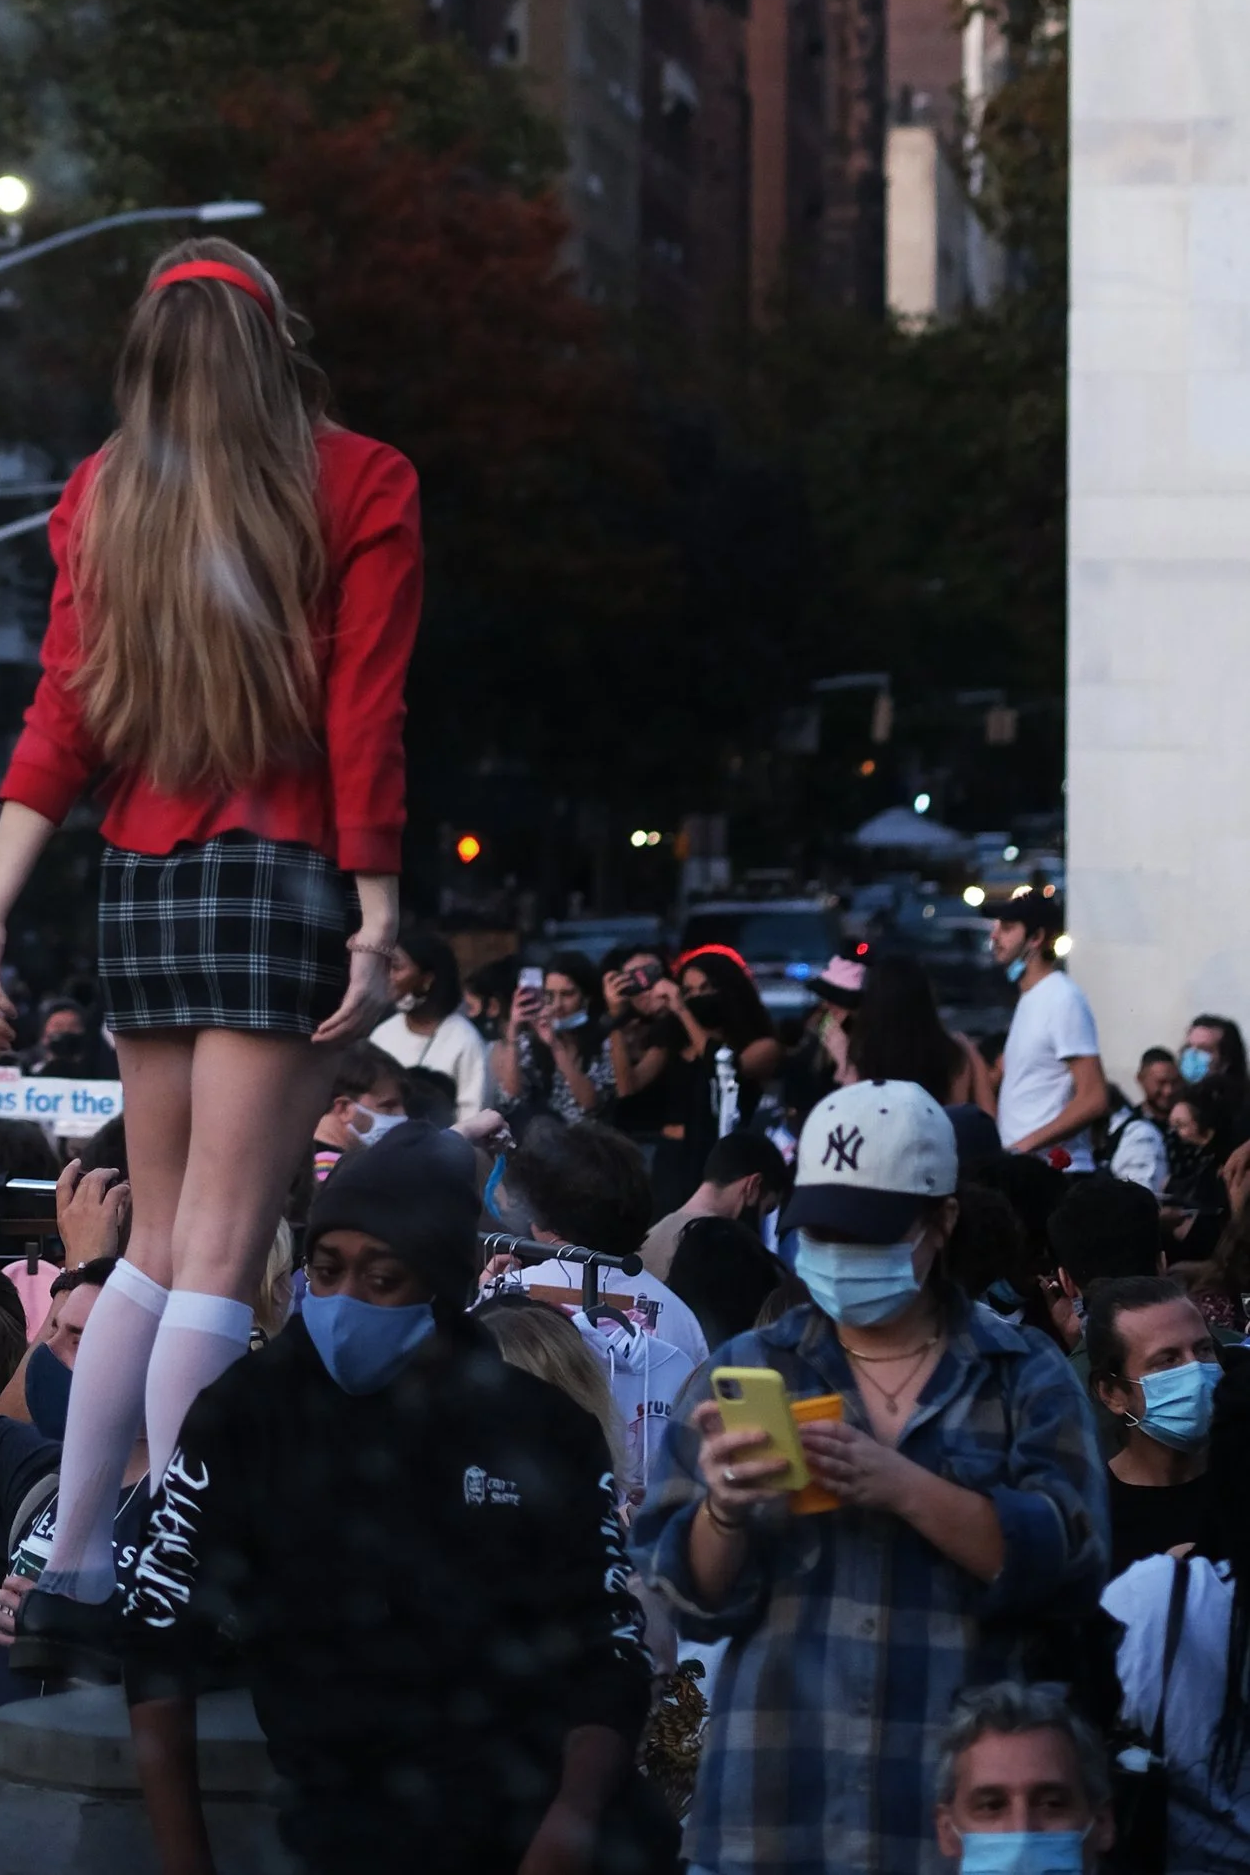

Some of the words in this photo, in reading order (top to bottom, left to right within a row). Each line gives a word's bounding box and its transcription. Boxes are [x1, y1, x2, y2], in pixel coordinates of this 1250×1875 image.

[25, 1087, 64, 1113] for
[72, 1088, 114, 1114] the
[821, 1123, 865, 1171] NY
